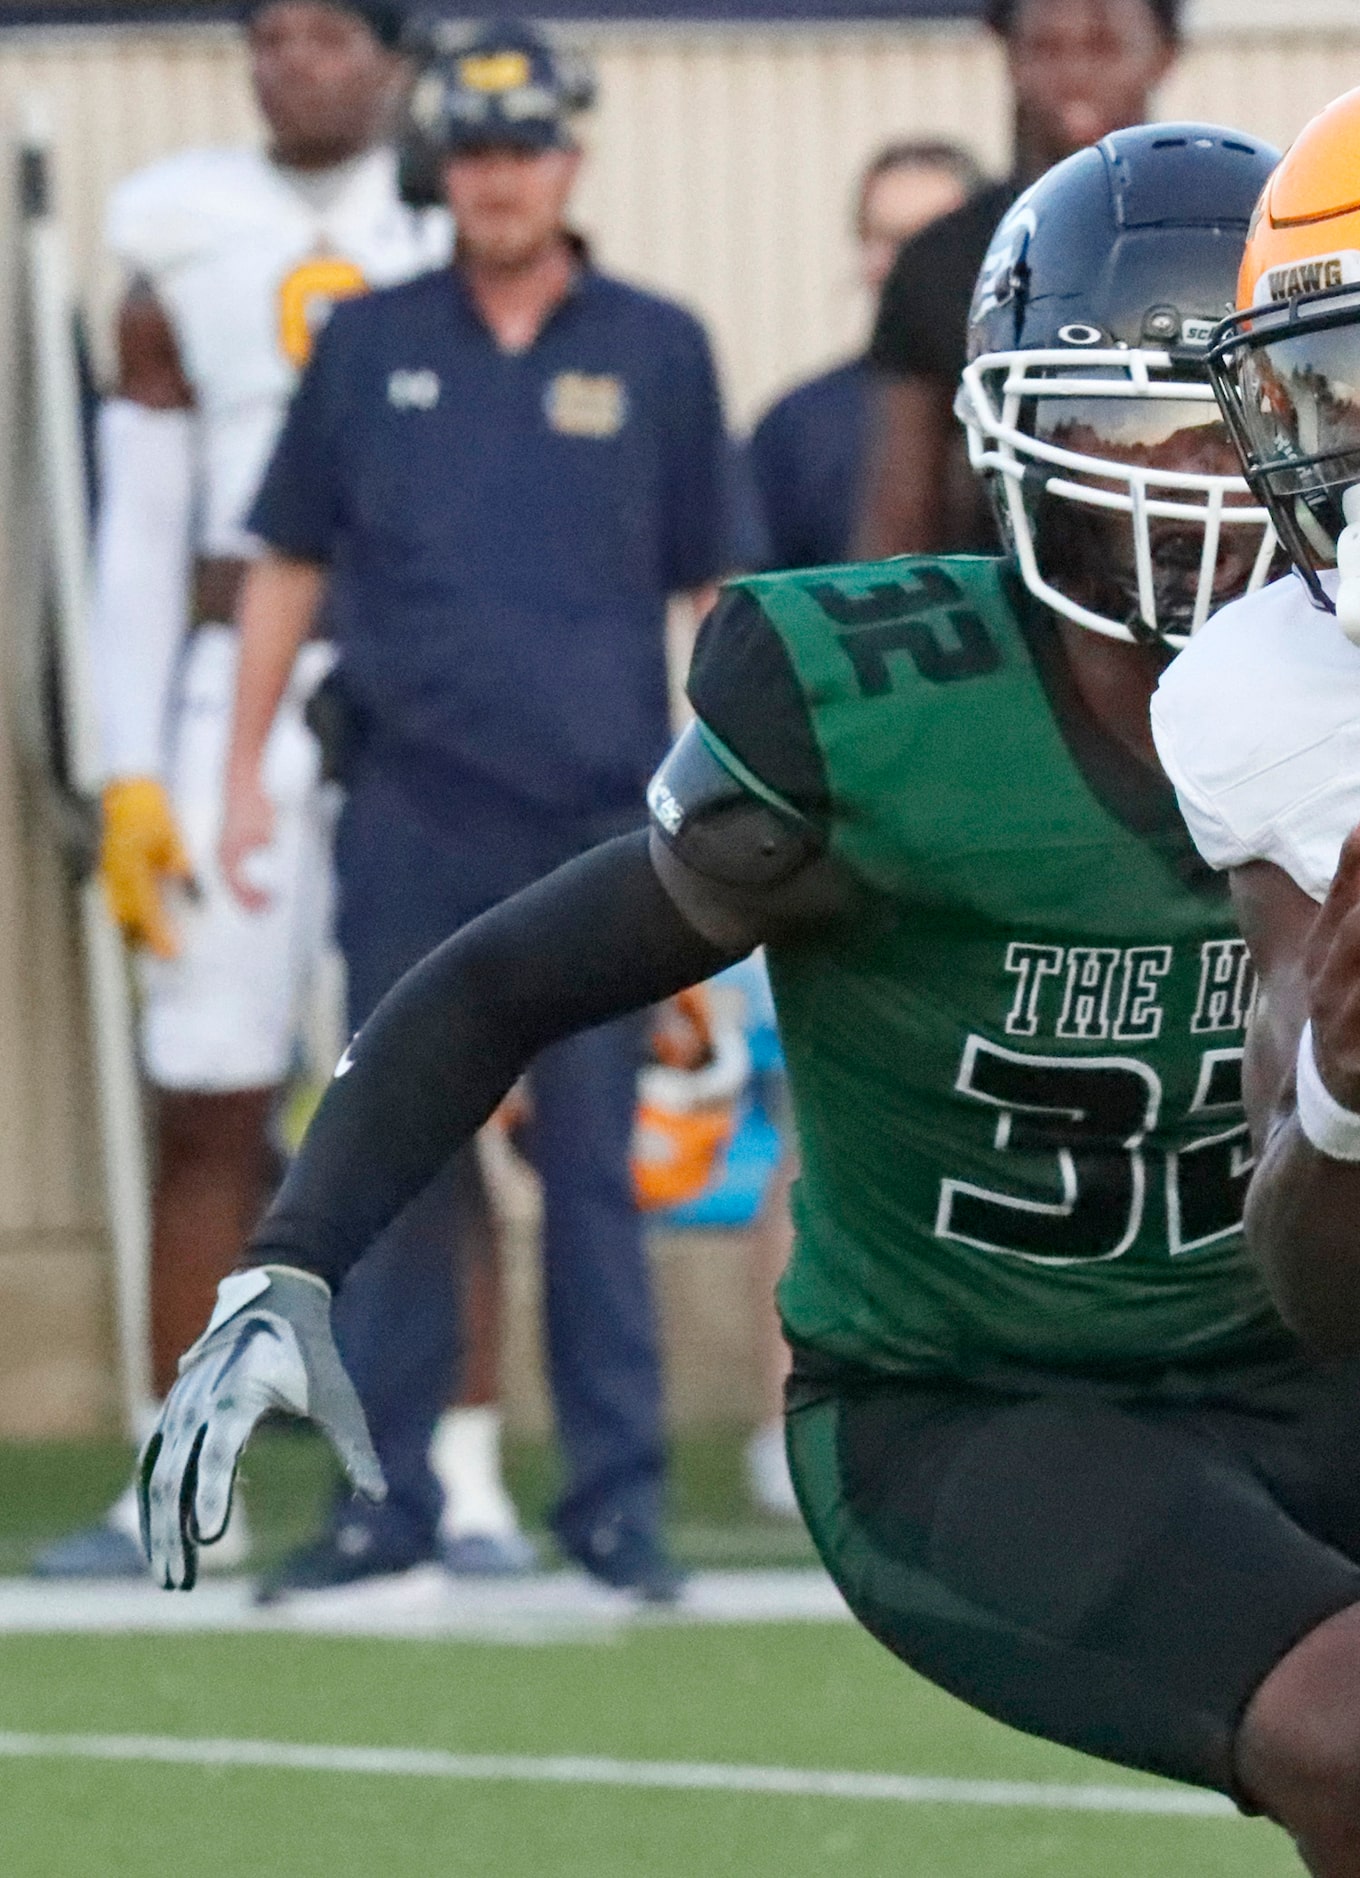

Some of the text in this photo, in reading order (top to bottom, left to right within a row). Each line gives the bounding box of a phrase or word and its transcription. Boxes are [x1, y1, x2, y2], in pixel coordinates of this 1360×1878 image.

[1267, 258, 1342, 301] WAWG
[1005, 939, 1258, 1040] THE H
